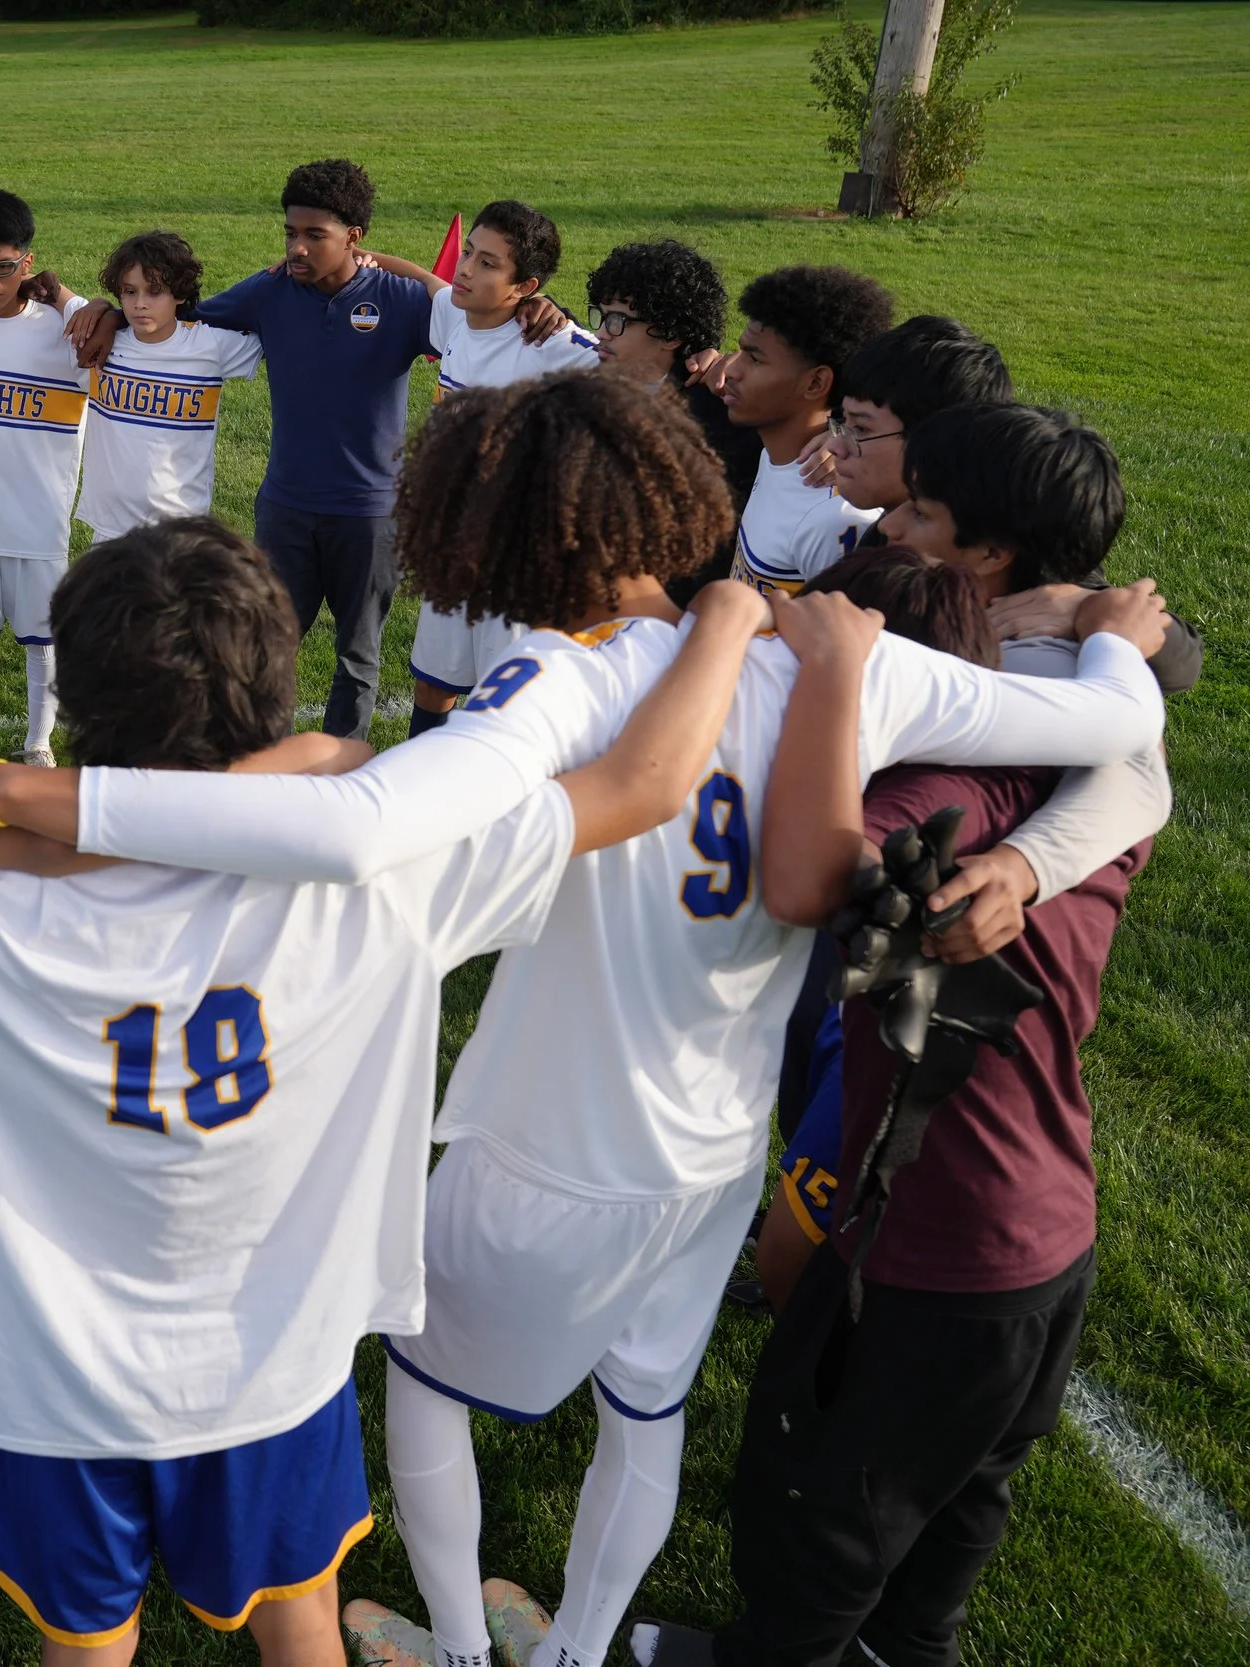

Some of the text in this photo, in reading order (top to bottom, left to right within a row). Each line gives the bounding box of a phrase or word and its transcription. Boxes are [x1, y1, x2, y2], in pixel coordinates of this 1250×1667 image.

[98, 374, 204, 418] KNIGHTS
[464, 657, 545, 714] 9
[680, 768, 752, 922] 9
[102, 981, 275, 1137] 18
[790, 1156, 839, 1209] 15
